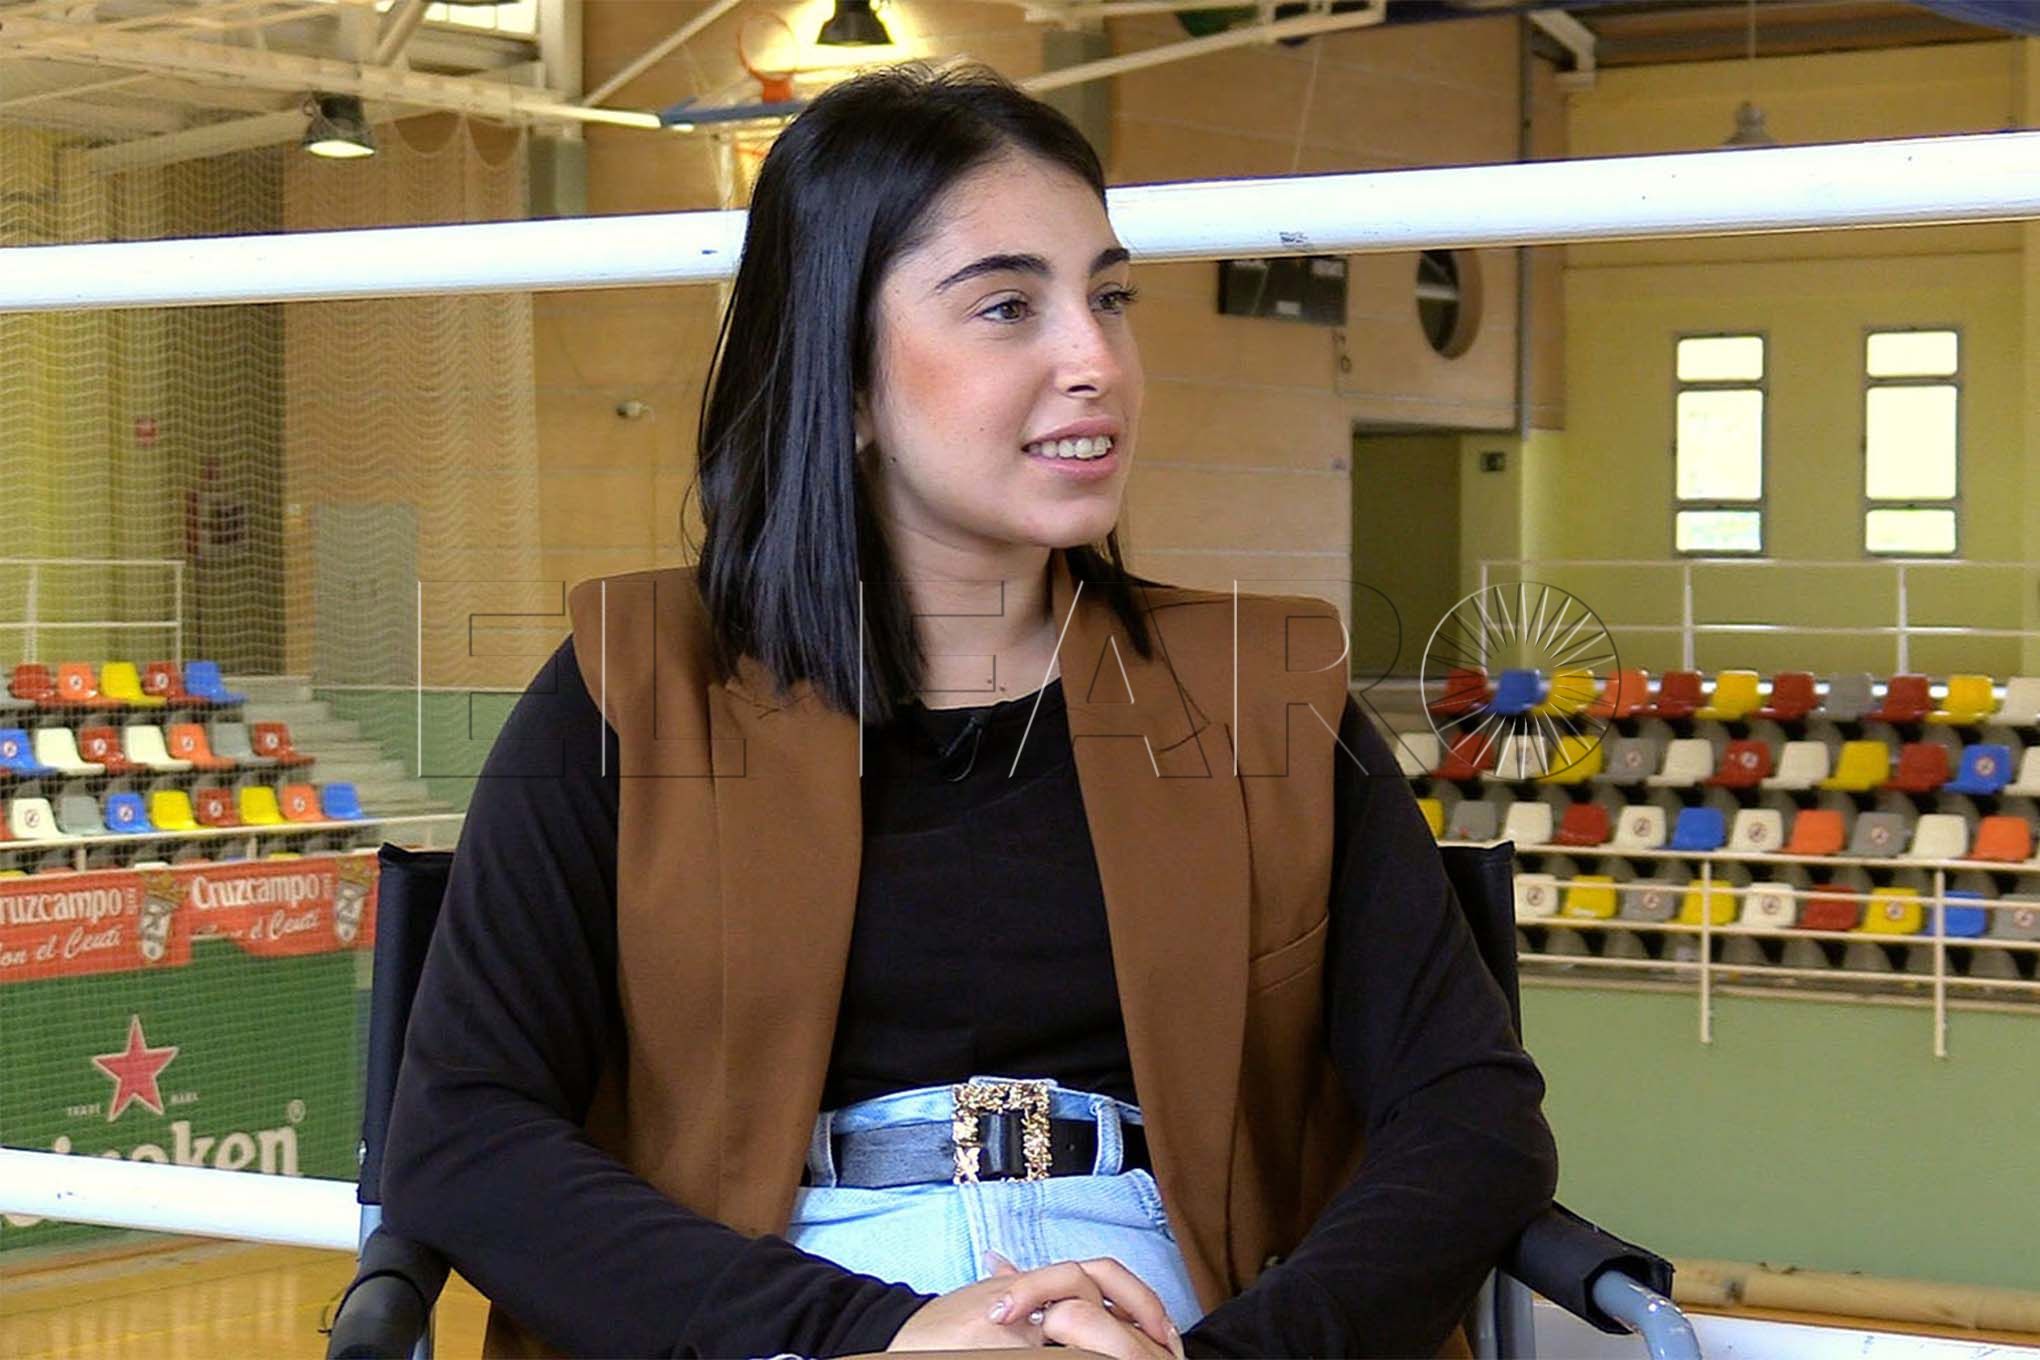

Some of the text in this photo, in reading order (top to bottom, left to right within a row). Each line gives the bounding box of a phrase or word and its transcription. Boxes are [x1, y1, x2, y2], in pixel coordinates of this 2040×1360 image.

[0, 888, 123, 925] ruzcampo
[191, 873, 321, 909] Cruzcampo
[0, 942, 28, 967] on
